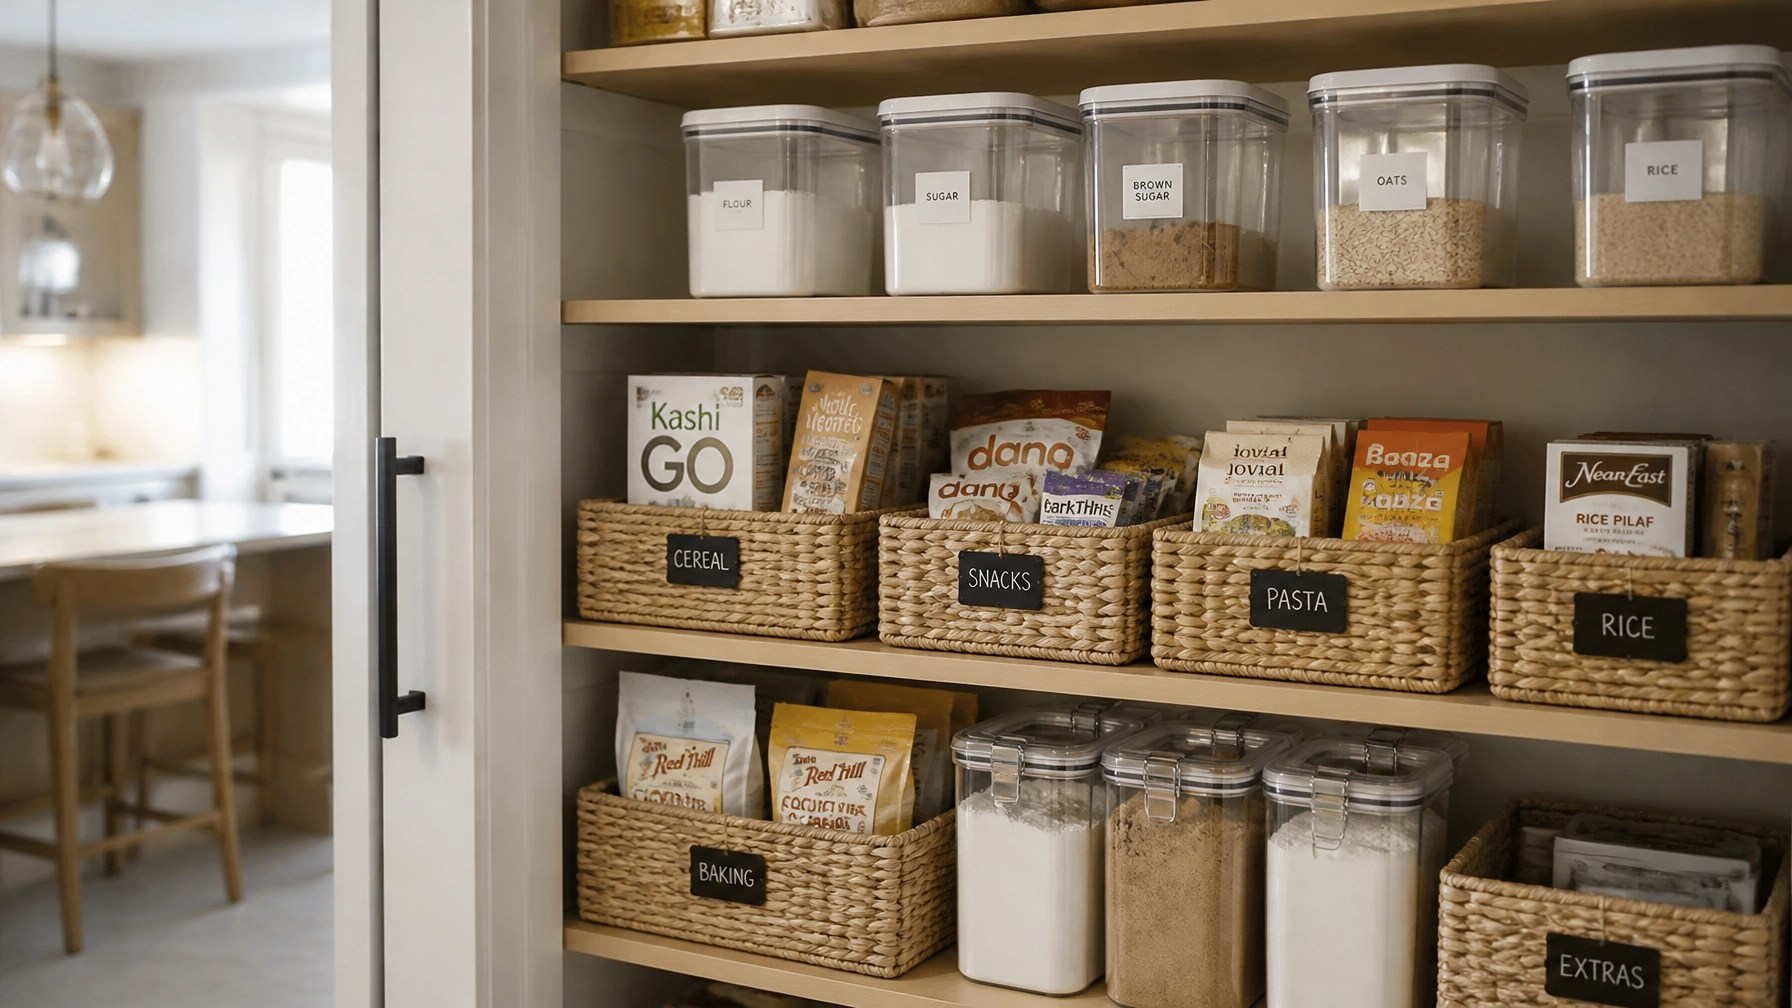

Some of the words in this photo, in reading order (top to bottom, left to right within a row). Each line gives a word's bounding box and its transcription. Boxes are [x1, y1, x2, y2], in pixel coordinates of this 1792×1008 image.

[1376, 174, 1408, 186] OATS
[1646, 164, 1678, 176] RICE
[925, 191, 959, 202] SUGAR
[1132, 180, 1173, 191] BROWN
[1134, 191, 1171, 202] SUGAR
[722, 199, 753, 209] FLOUR
[651, 401, 720, 431] Kashi
[641, 435, 734, 494] GO
[1624, 463, 1667, 488] East
[1576, 513, 1609, 526] RICE
[1613, 515, 1655, 528] PILAF
[673, 549, 730, 571] CEREAL
[968, 567, 1031, 592] SNACKS
[1267, 587, 1328, 613] PASTA
[1602, 612, 1655, 639] RICE
[699, 862, 755, 888] BAKING
[1559, 953, 1645, 990] EXTRAS
